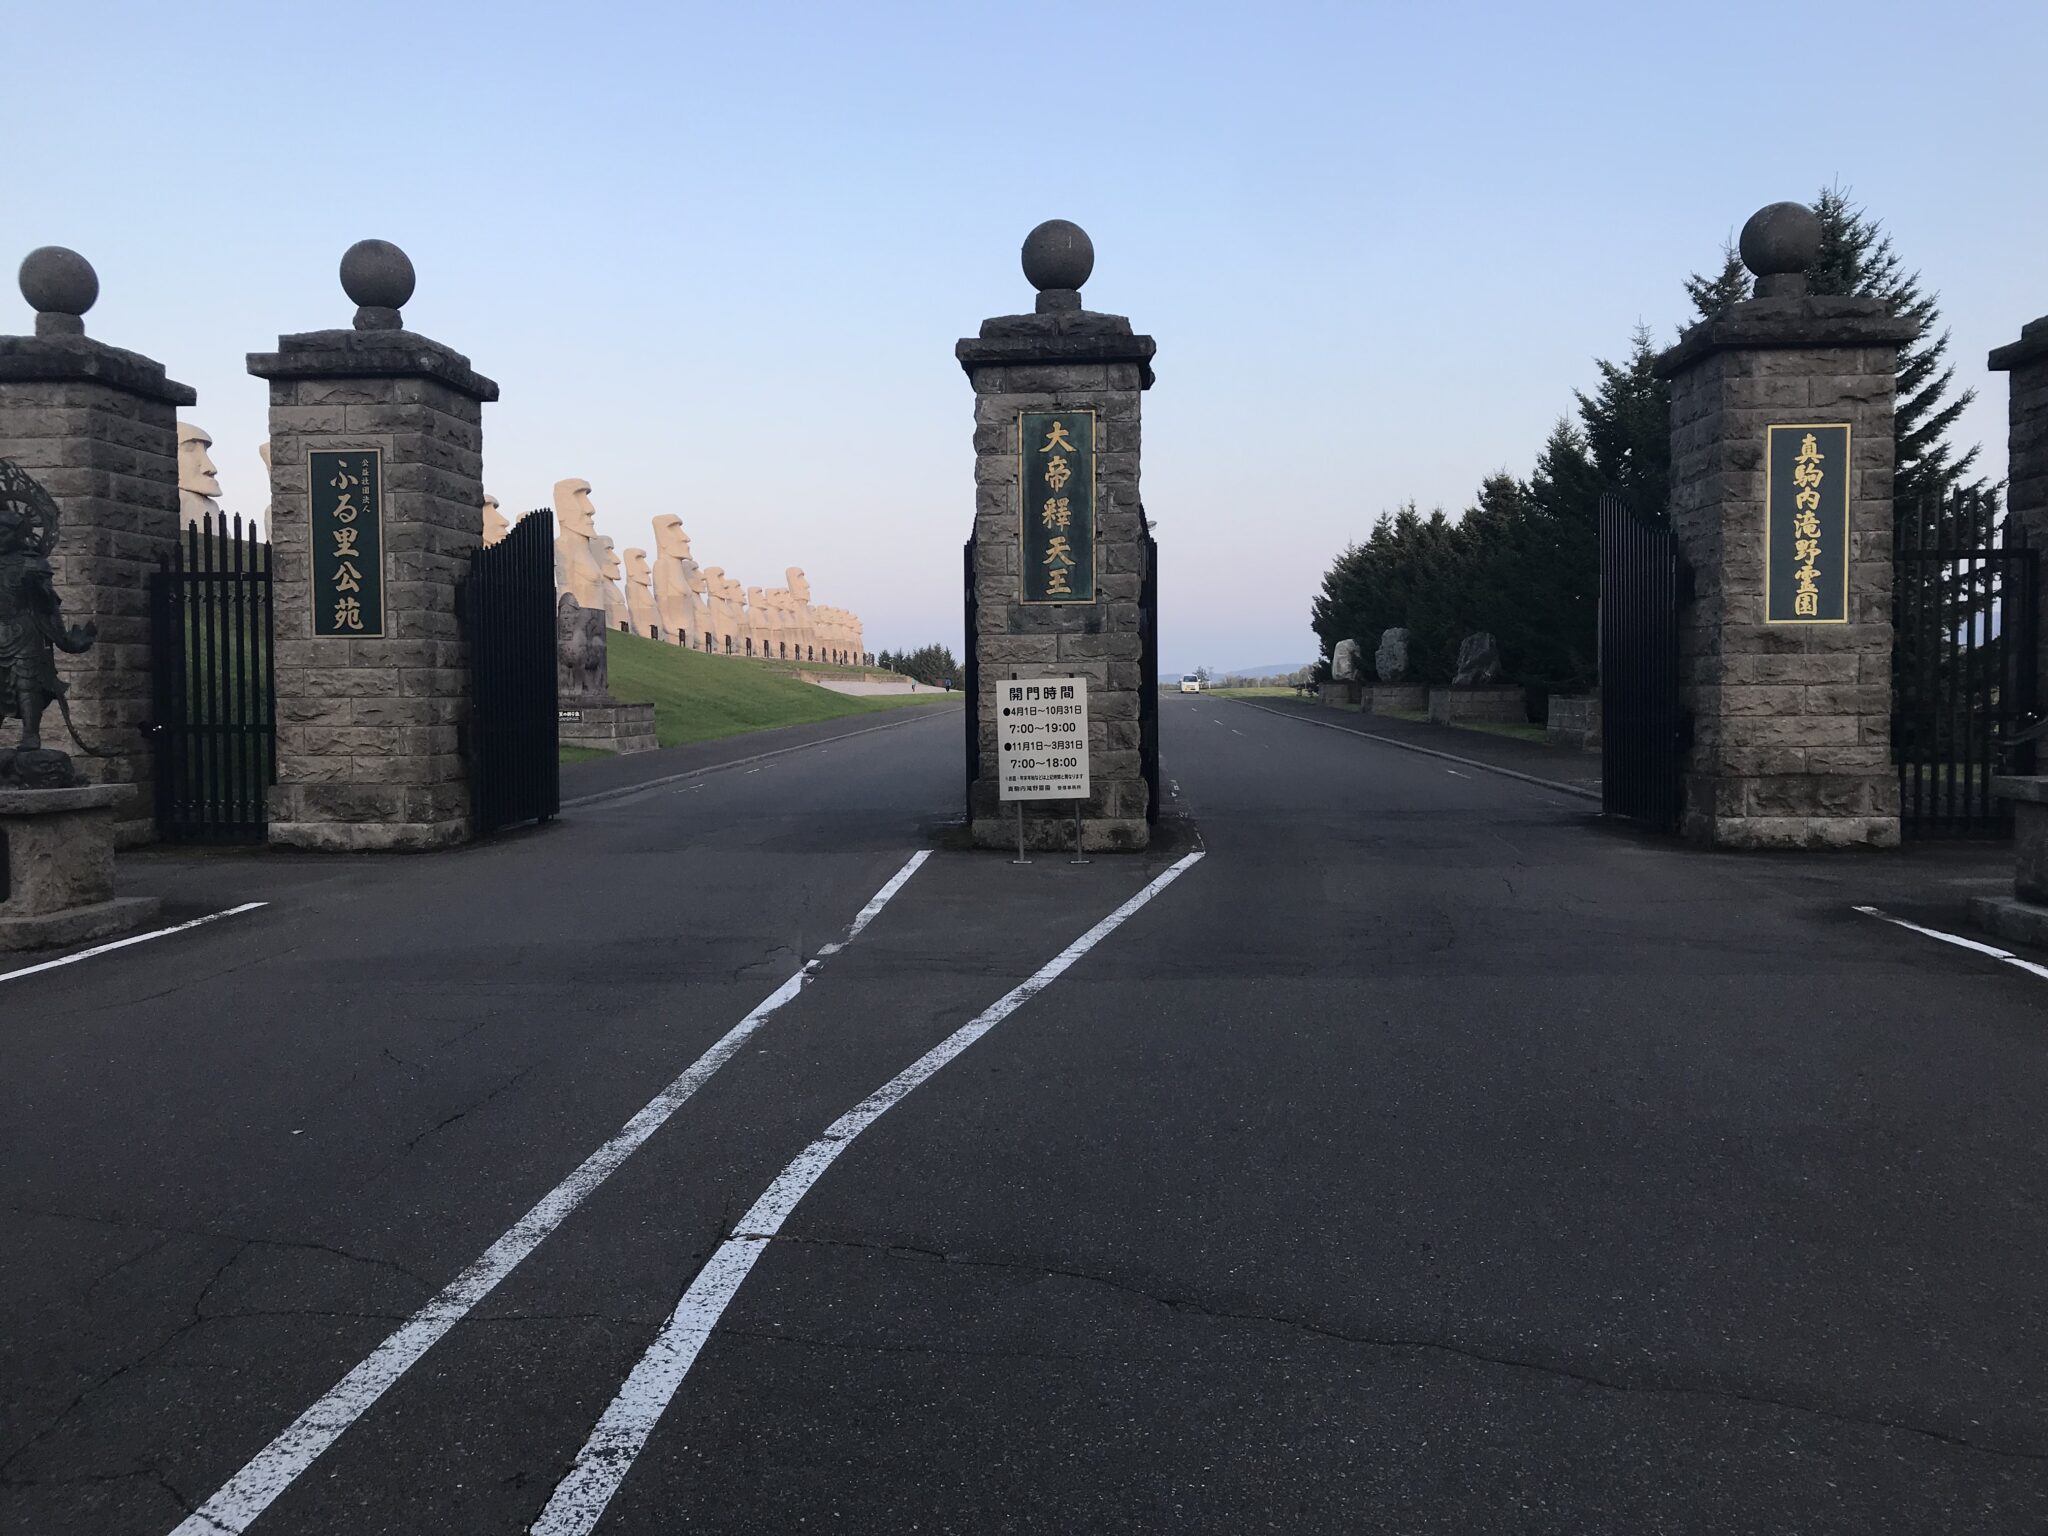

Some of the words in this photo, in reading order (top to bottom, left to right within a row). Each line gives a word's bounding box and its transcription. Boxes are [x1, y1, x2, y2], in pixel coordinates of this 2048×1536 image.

[361, 458, 371, 513] 公益社団法人
[1793, 433, 1825, 616] 真駒内滝野霊園
[330, 459, 364, 630] ふる里公苑
[1009, 686, 1074, 701] 開門時間
